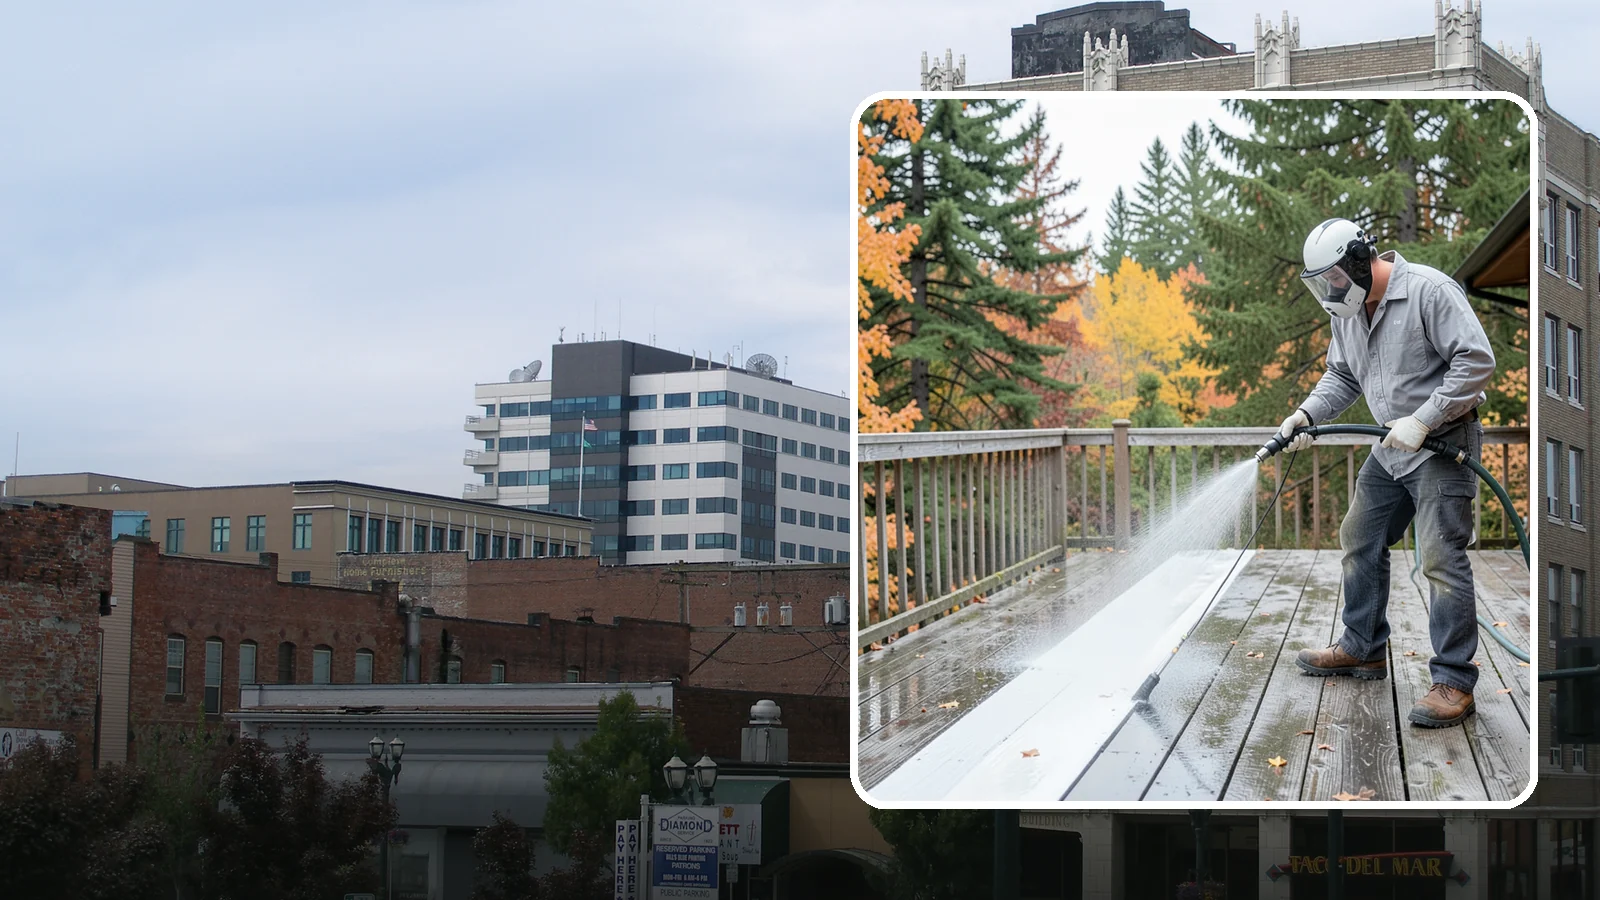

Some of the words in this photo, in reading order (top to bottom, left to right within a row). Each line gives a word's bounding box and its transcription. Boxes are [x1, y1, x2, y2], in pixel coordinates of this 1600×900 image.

[370, 566, 427, 576] Furnishers
[660, 818, 713, 833] DIAMOND
[1021, 815, 1070, 828] BUILDING
[617, 825, 625, 852] PAY
[628, 824, 637, 852] PAY
[655, 845, 688, 853] RESERVED
[689, 846, 716, 854] PARKING
[671, 861, 701, 870] PATRONS
[1289, 855, 1329, 874] TAC
[1346, 855, 1385, 875] DEL
[1392, 857, 1443, 877] MAR
[616, 856, 625, 893] HERE
[628, 855, 636, 893] HERE
[660, 888, 682, 897] PUBLIC
[683, 889, 710, 898] PARKING
